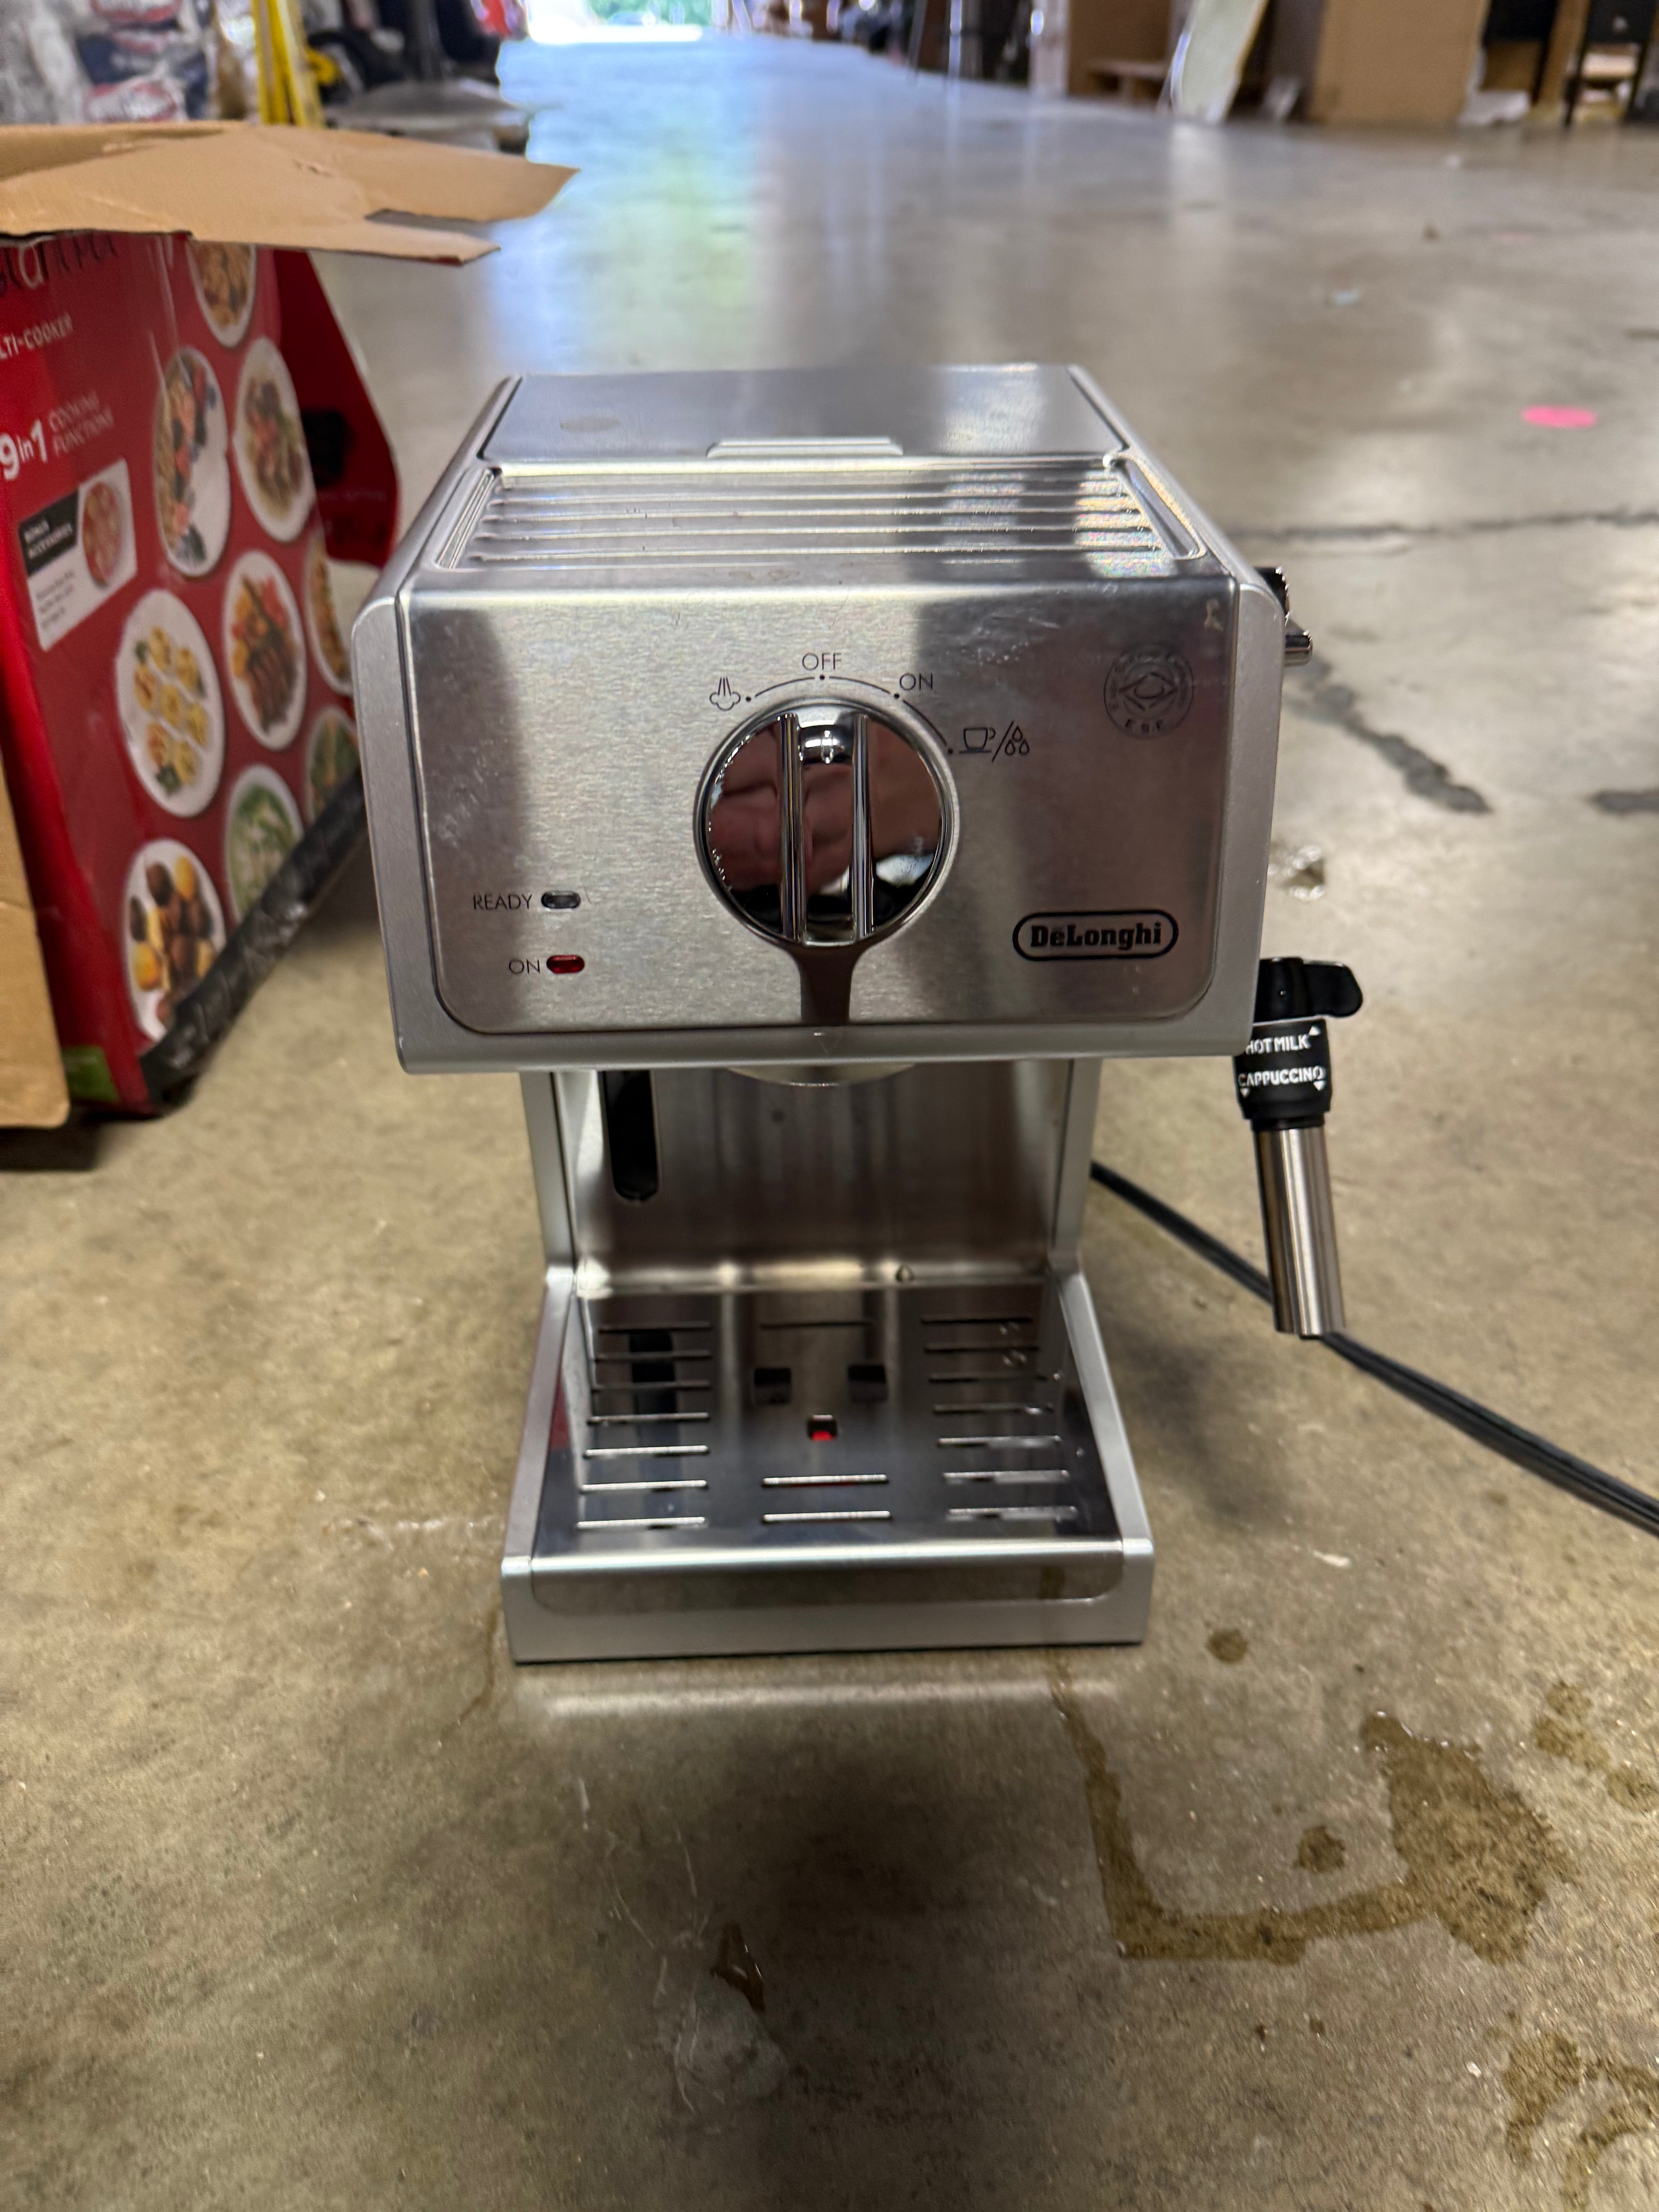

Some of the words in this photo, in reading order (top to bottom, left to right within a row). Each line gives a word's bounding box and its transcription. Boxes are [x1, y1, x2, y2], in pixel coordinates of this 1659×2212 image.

[802, 653, 842, 671] OFF
[899, 673, 933, 691] ON
[473, 893, 532, 910] READY
[1031, 922, 1161, 950] DeLonghi
[508, 959, 540, 974] ON
[1274, 1034, 1311, 1052] MILK
[1238, 1065, 1326, 1087] CAPPUCCINO
